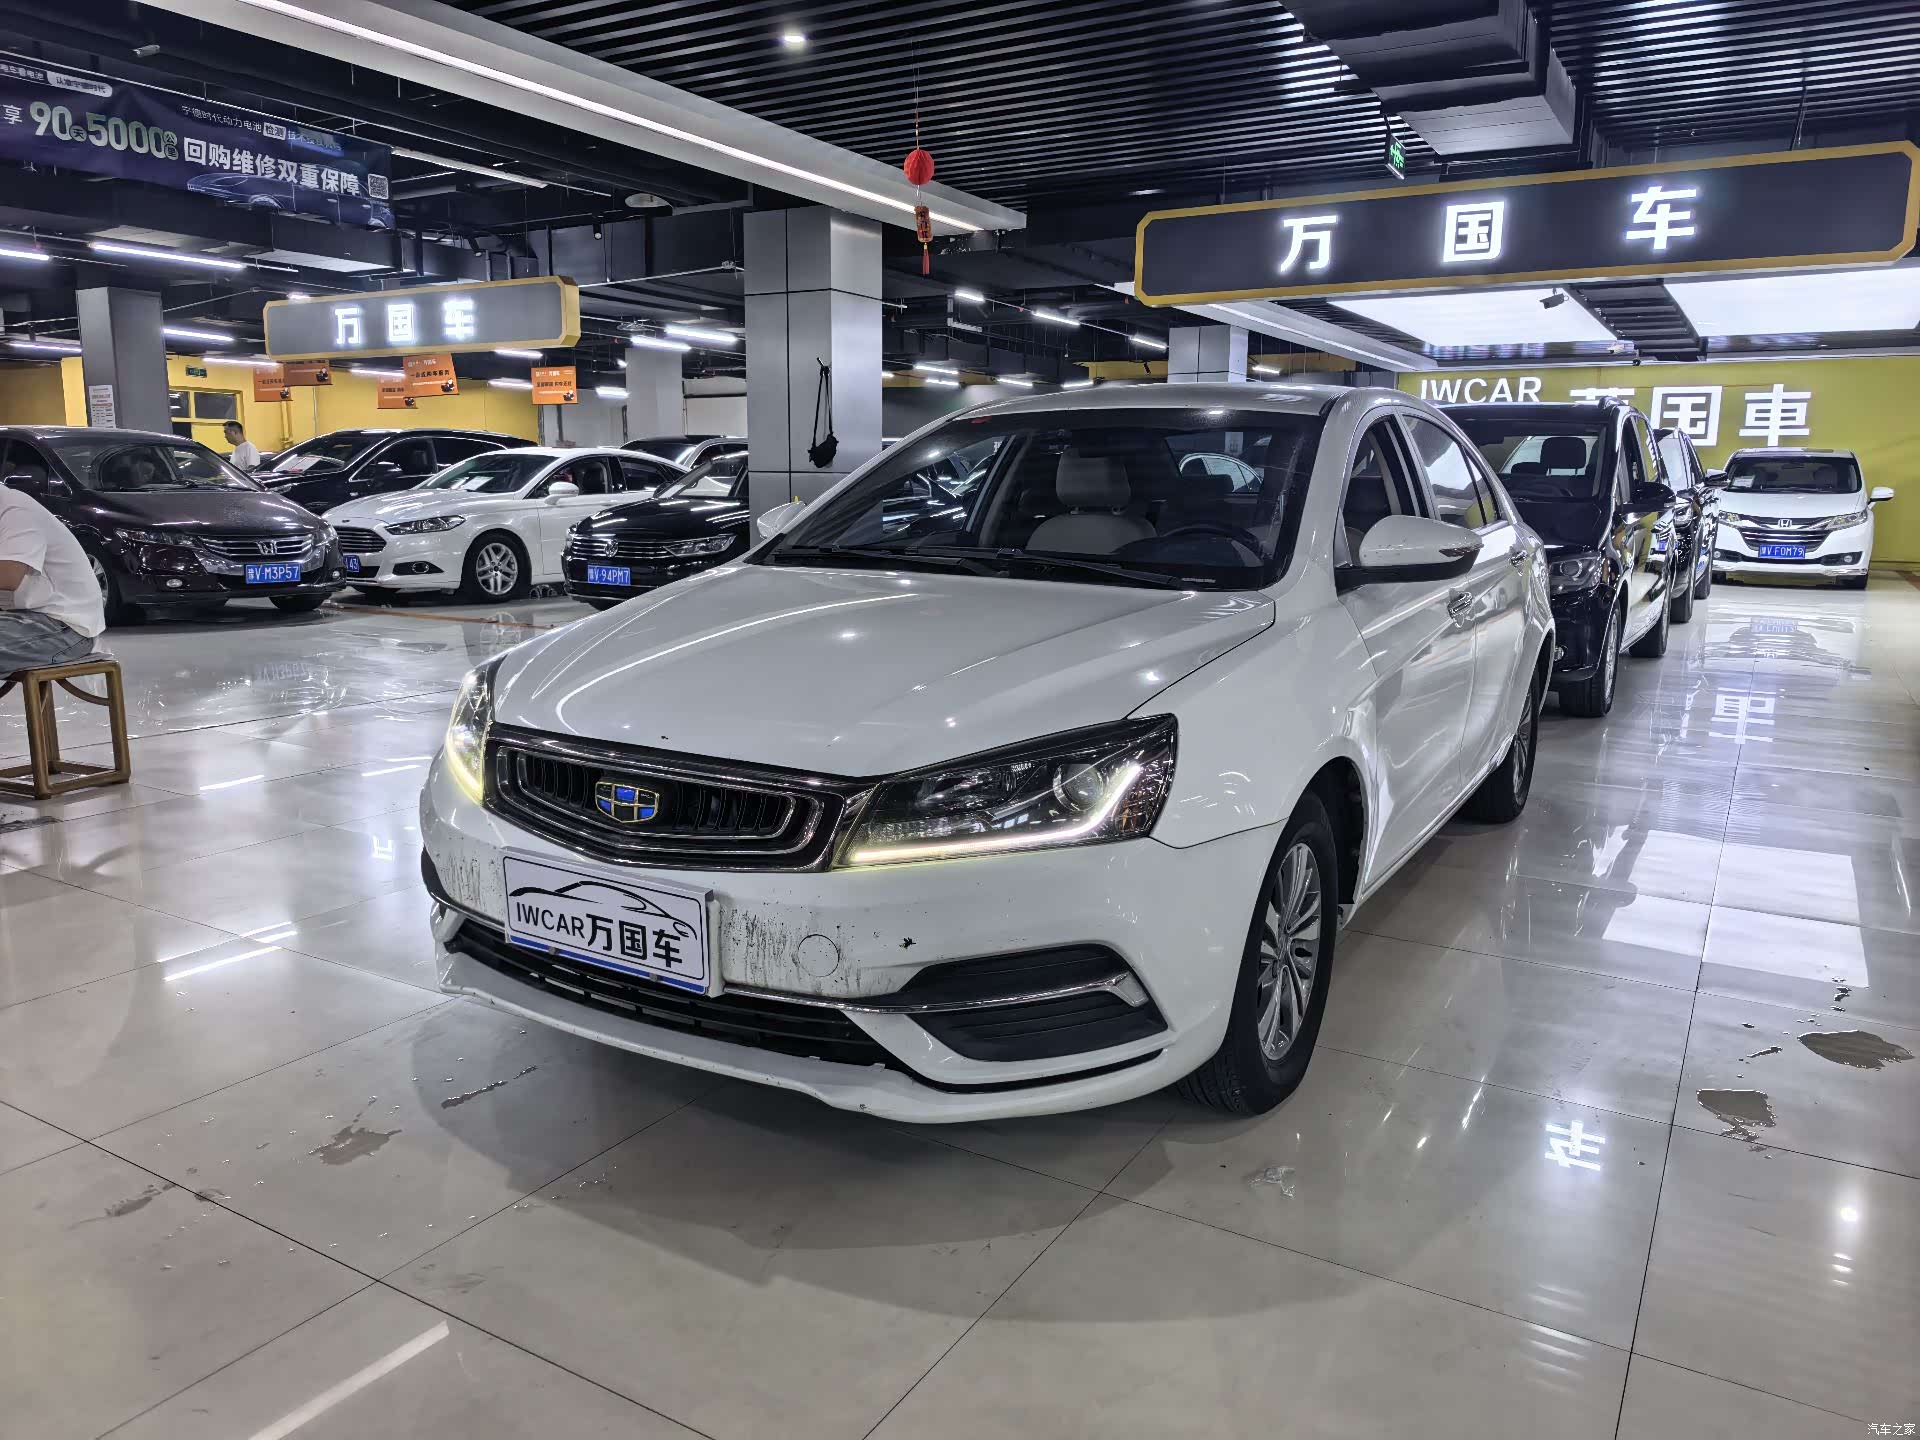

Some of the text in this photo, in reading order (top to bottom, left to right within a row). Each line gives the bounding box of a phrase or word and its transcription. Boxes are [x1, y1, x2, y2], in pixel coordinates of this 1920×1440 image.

[3, 104, 22, 124] 享
[183, 137, 360, 196] 回购维修双重保障
[1279, 185, 1697, 273] 万国车
[334, 298, 474, 345] 万国车
[1420, 377, 1812, 447] IWCAR 国車
